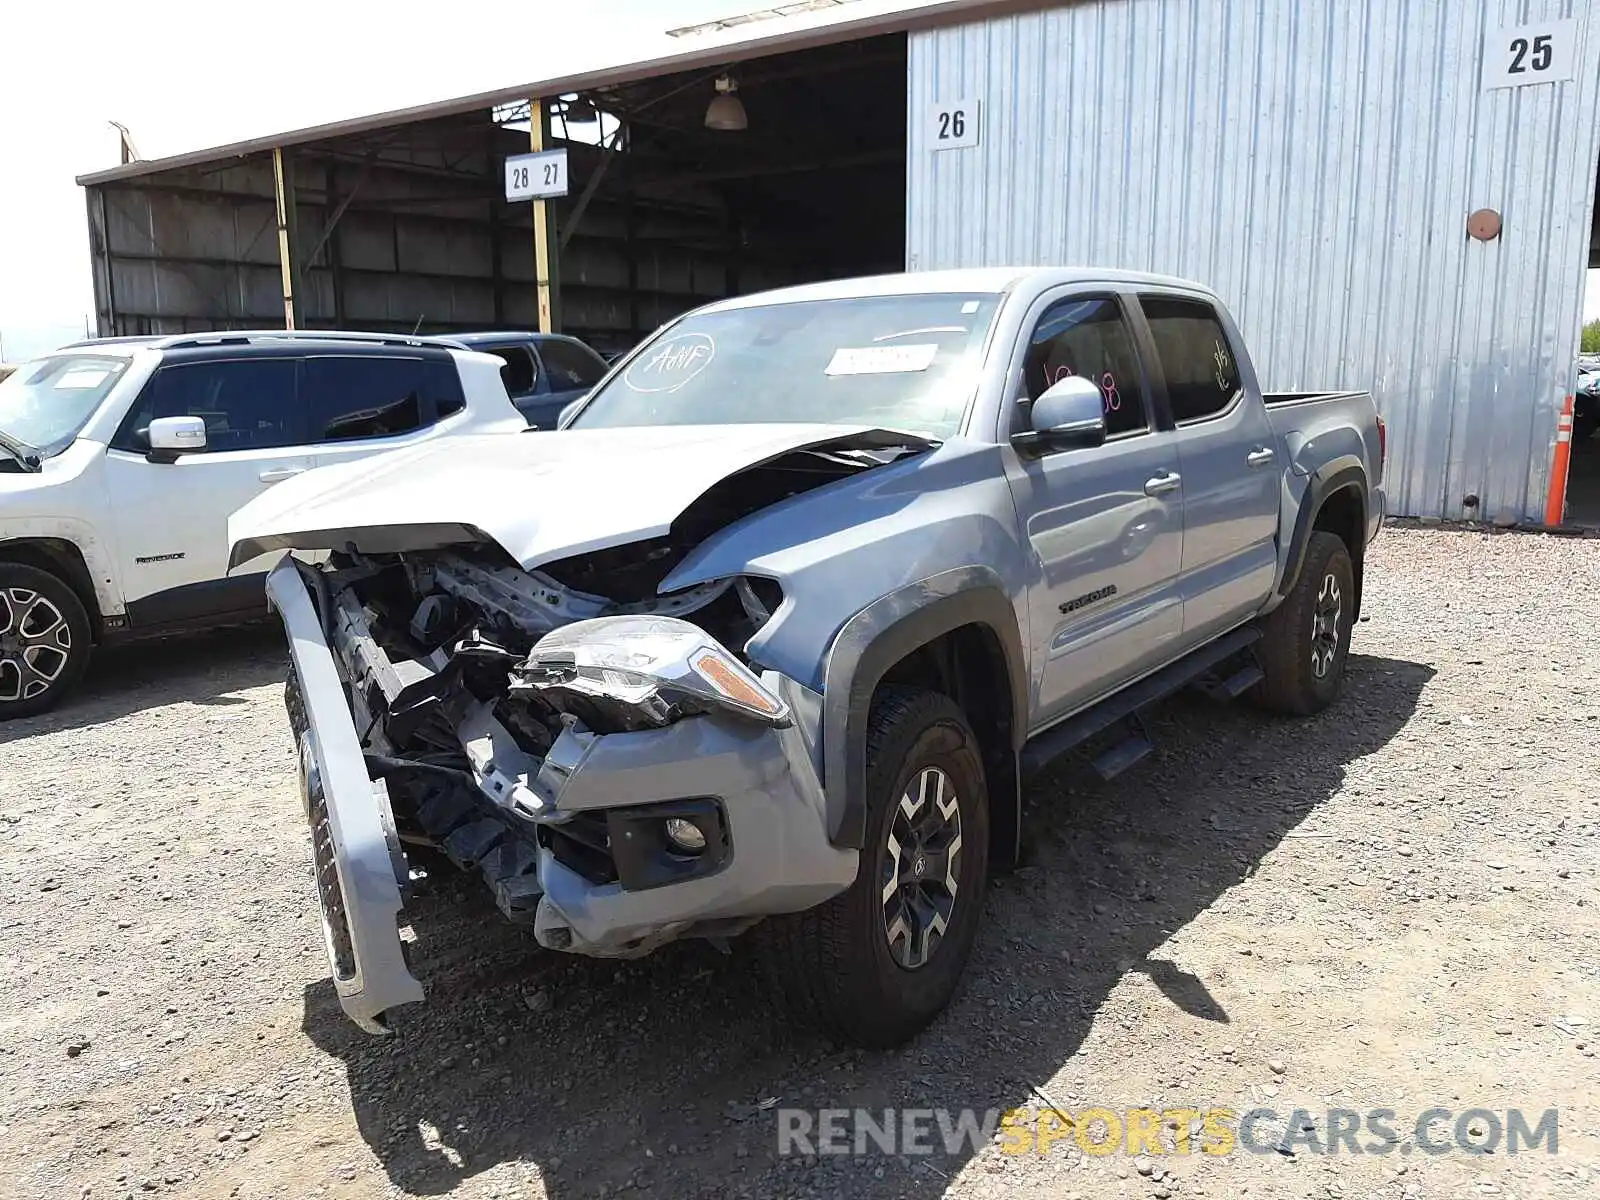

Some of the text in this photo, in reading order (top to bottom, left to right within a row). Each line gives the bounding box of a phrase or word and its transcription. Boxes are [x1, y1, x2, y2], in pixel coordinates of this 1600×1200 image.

[1508, 34, 1552, 74] 25
[939, 110, 965, 140] 26
[513, 163, 558, 189] 28 27
[136, 552, 186, 564] RENEGADE
[1059, 584, 1118, 614] TACOMA
